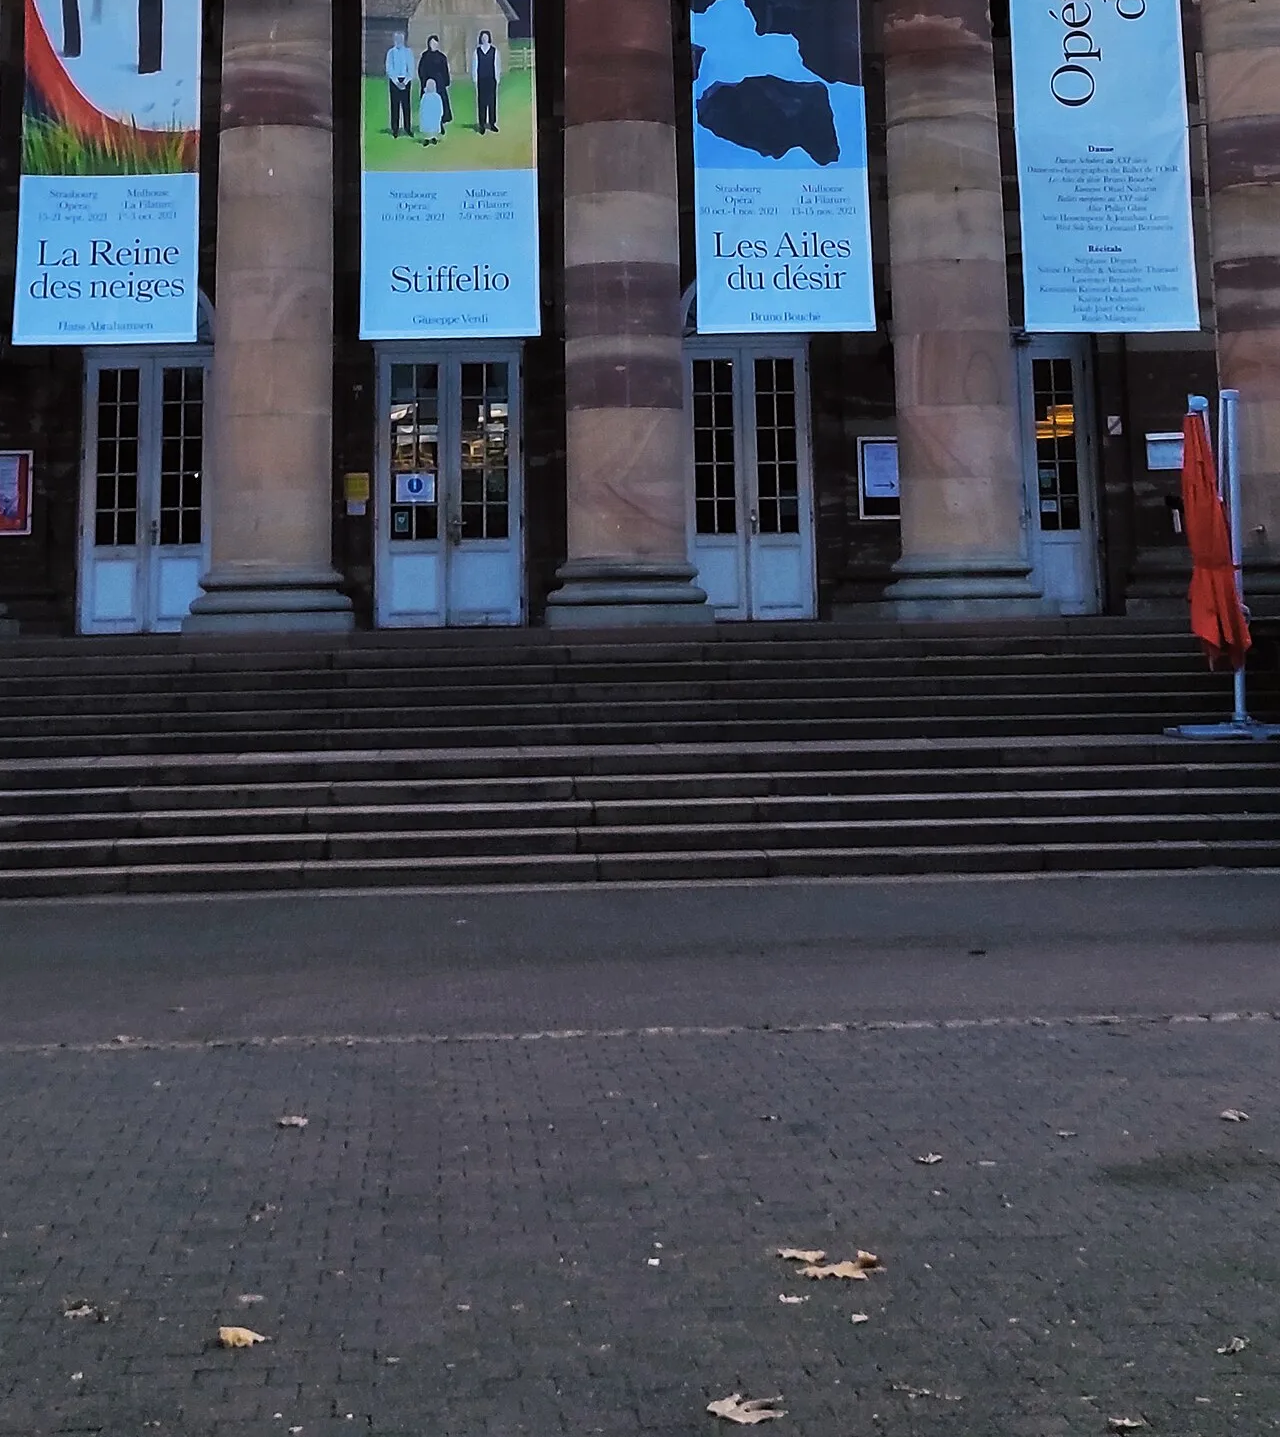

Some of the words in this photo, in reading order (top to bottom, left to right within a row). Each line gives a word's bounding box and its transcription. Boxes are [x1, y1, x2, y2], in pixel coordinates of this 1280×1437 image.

[37, 240, 80, 266] La
[89, 239, 179, 266] Reine
[713, 232, 767, 258] Les
[774, 232, 850, 258] Ailes
[30, 273, 81, 299] des
[90, 272, 184, 302] neiges
[391, 265, 509, 292] Stiffelio
[728, 264, 765, 290] du
[774, 264, 847, 290] désir
[413, 315, 460, 325] Giuseppe
[461, 314, 488, 323] Verdi
[751, 312, 782, 321] Bruno
